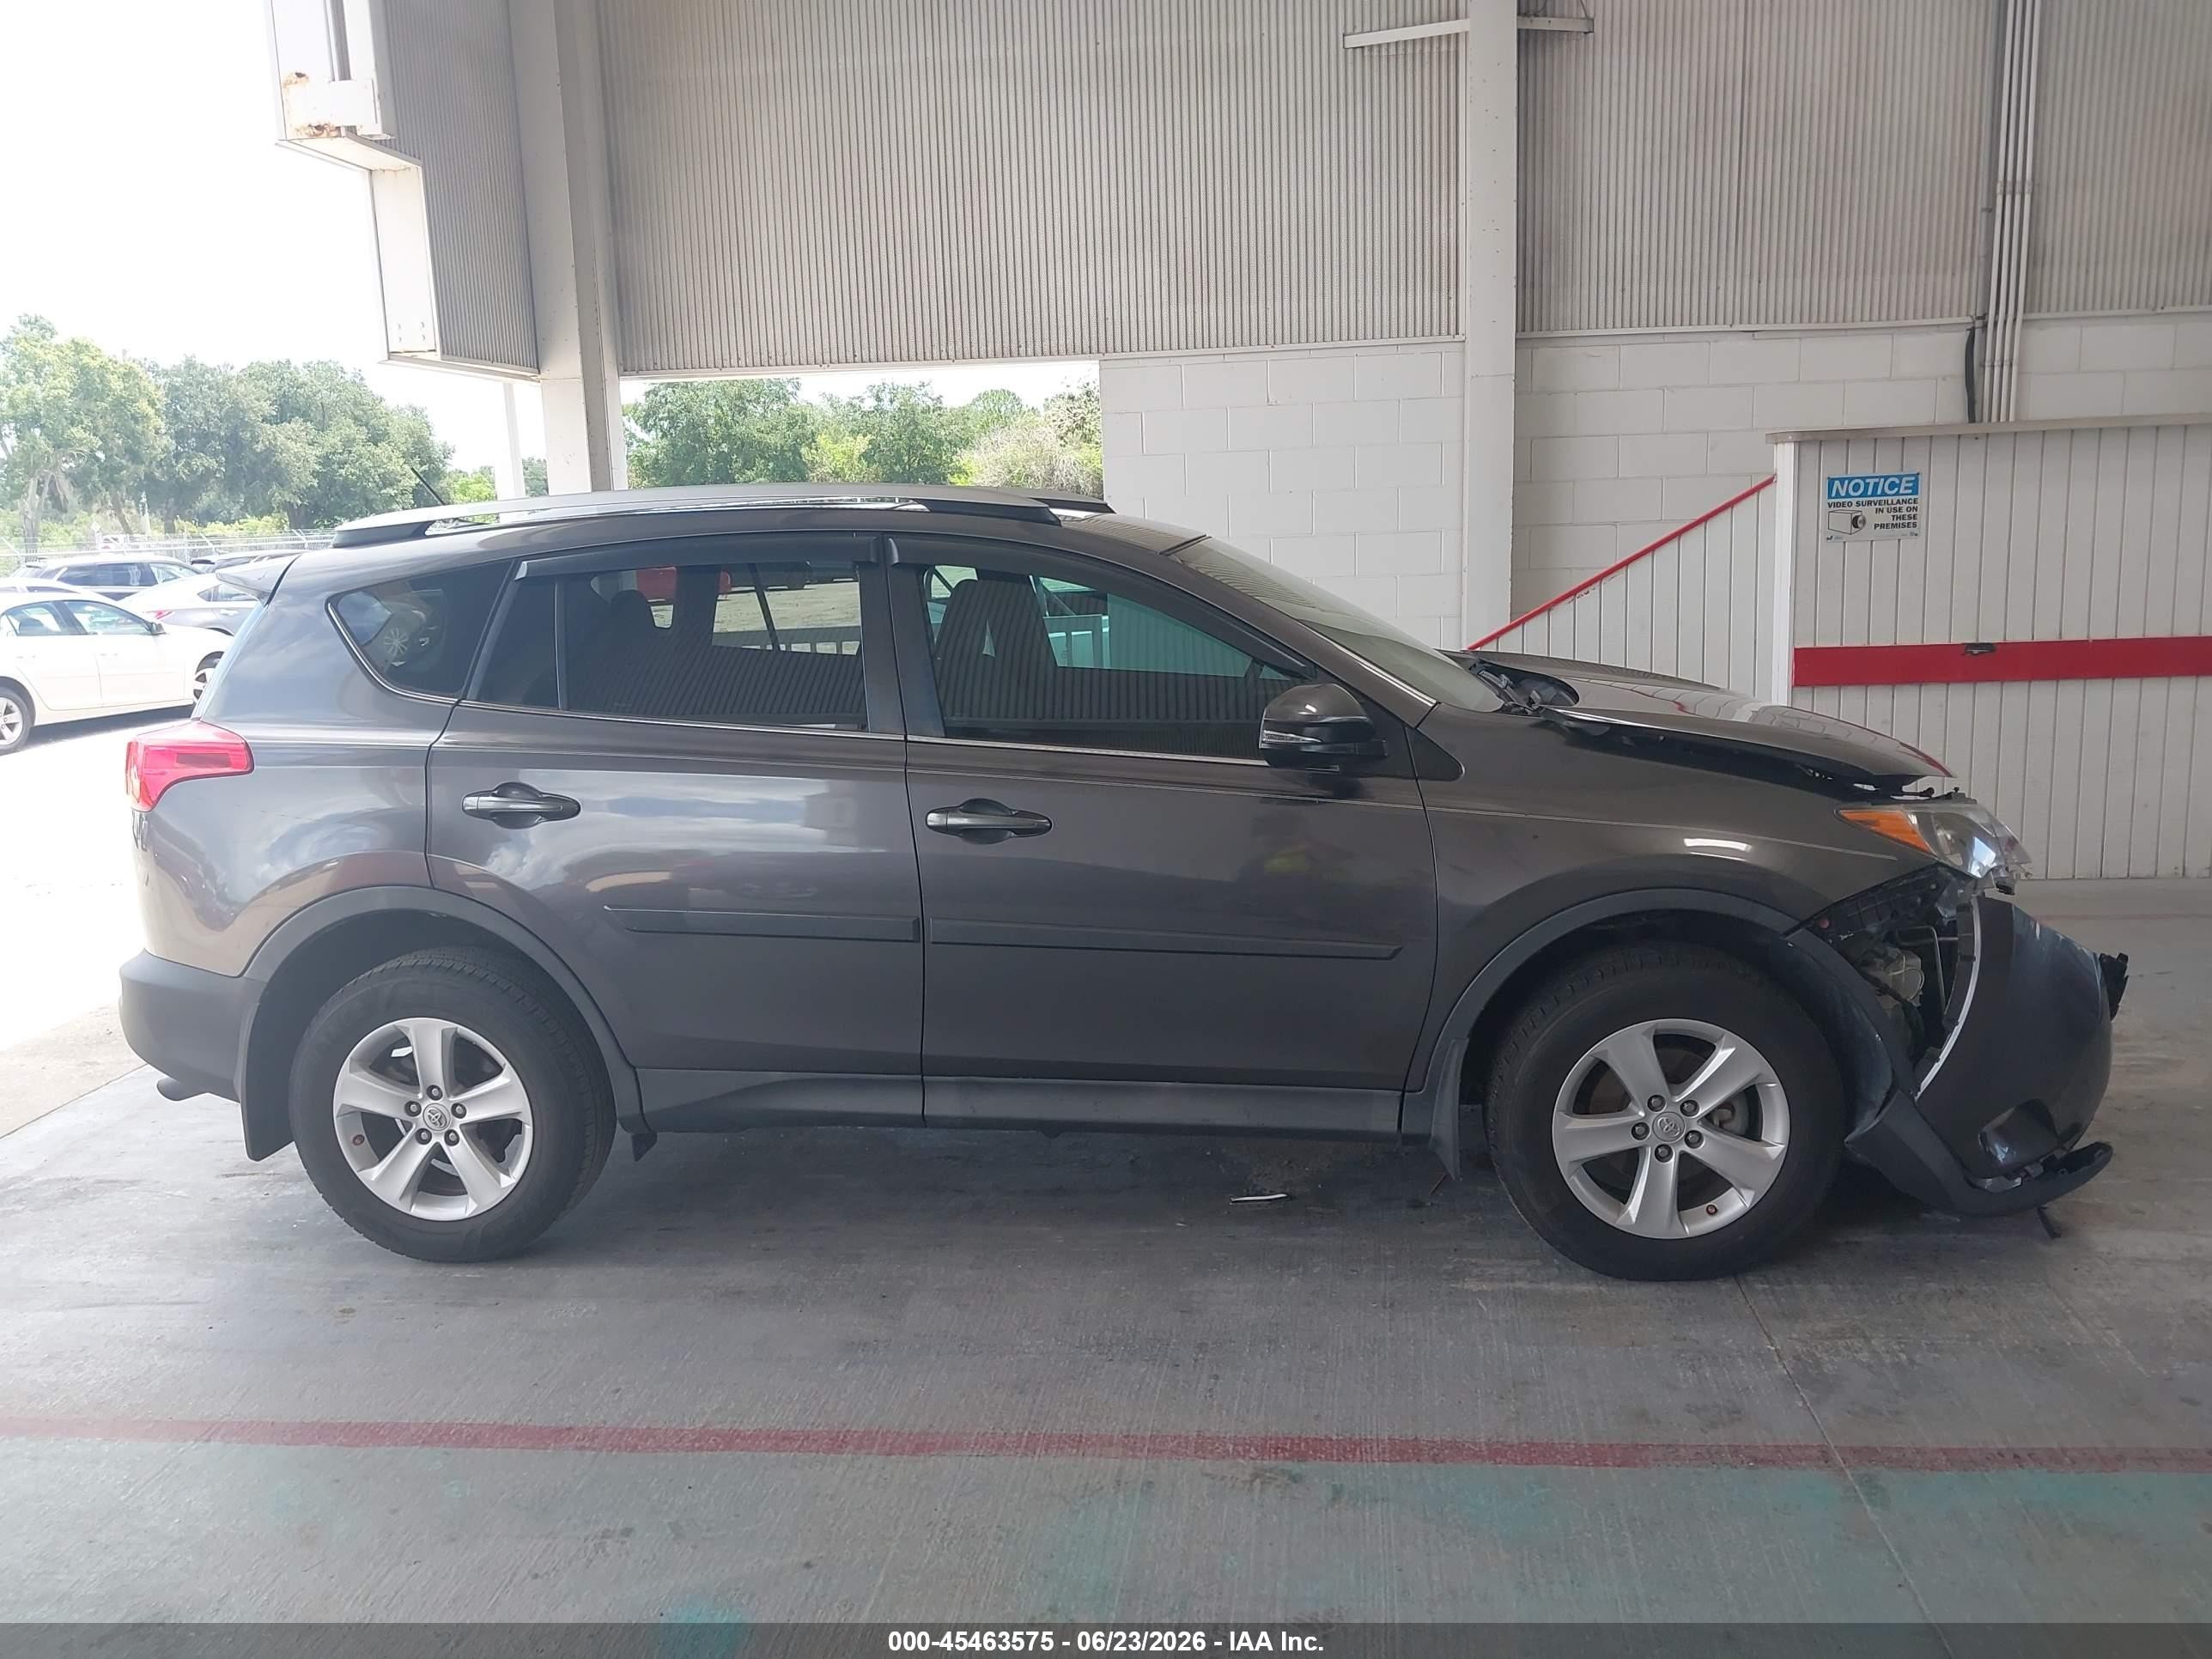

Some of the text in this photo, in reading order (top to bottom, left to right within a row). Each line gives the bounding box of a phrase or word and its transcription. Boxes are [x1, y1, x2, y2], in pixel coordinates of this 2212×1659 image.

[1831, 477, 1916, 497] NOTICE
[1855, 498, 1918, 507] SURVEILLANCE
[1874, 521, 1917, 530] PREMISES
